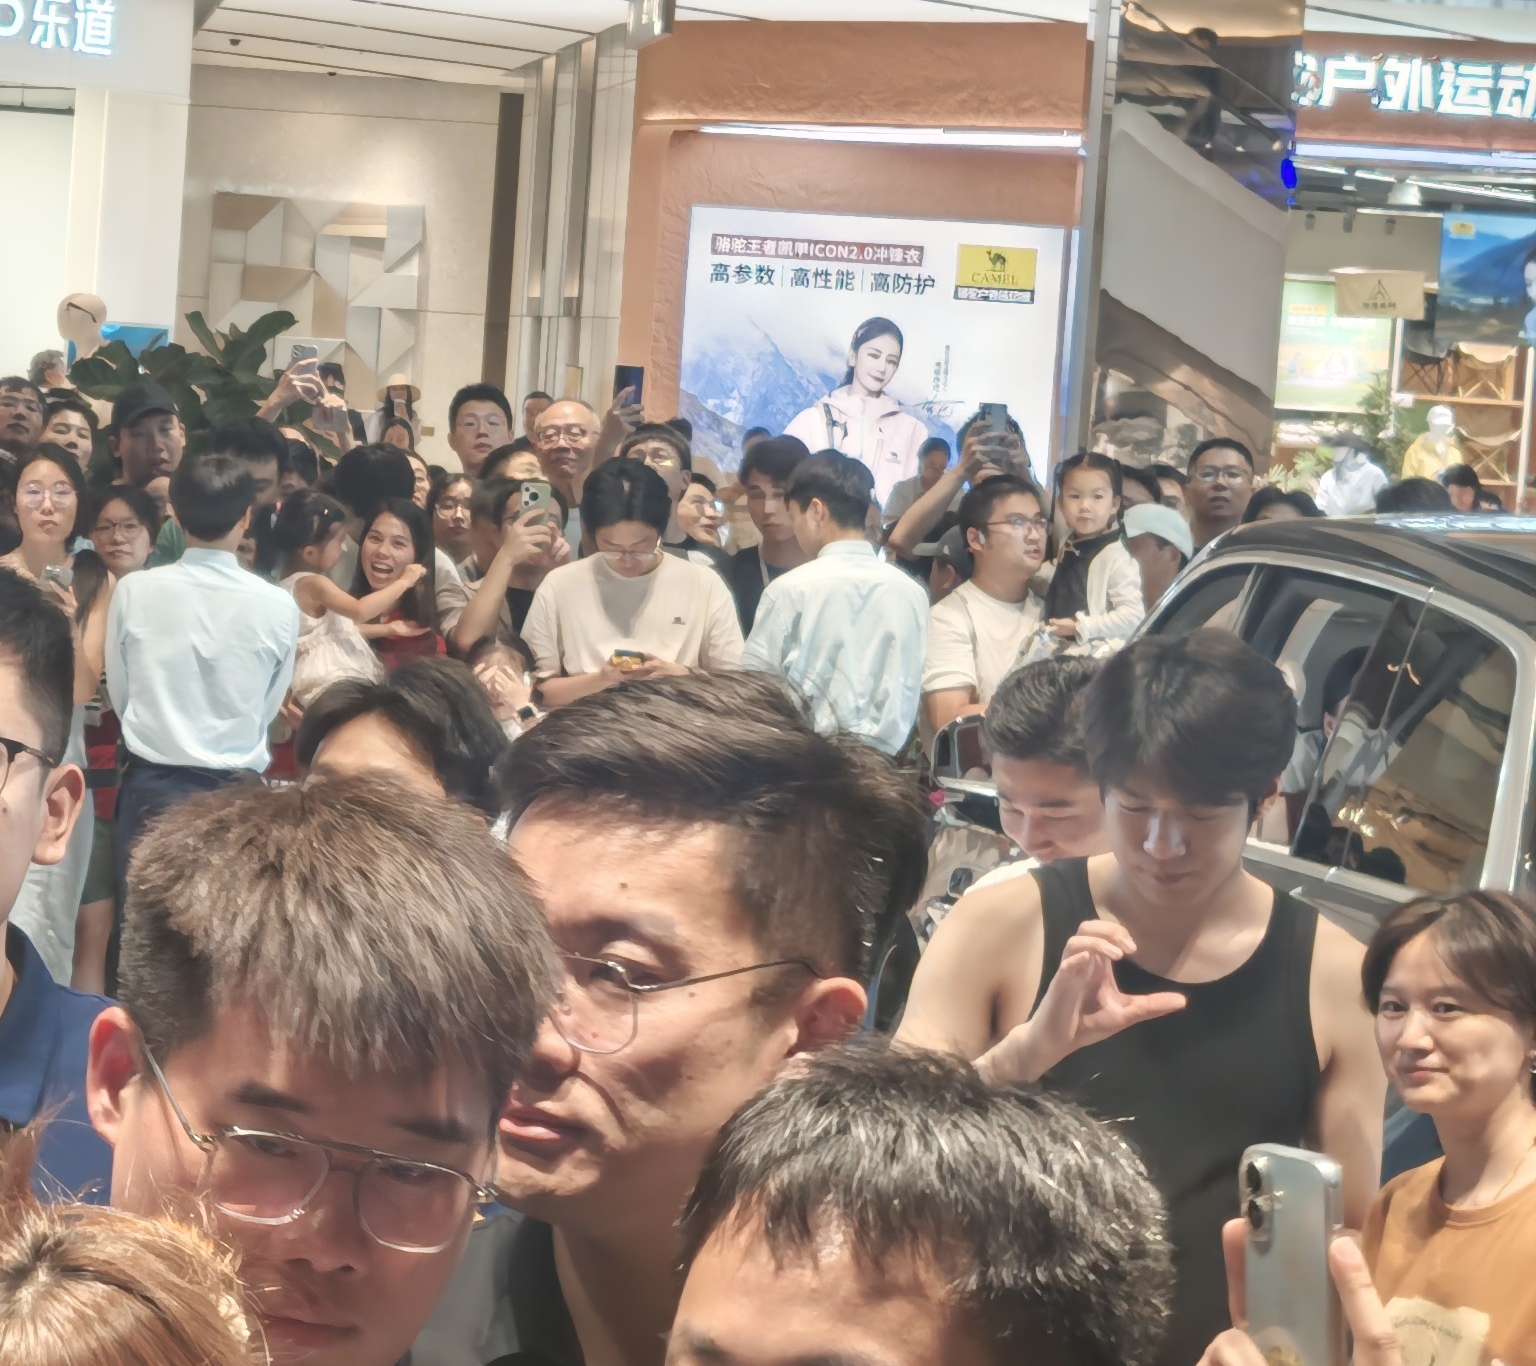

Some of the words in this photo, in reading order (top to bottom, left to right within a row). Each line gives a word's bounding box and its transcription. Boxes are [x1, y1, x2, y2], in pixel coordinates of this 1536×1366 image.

[790, 267, 855, 291] 高性能
[870, 272, 935, 295] 高防护
